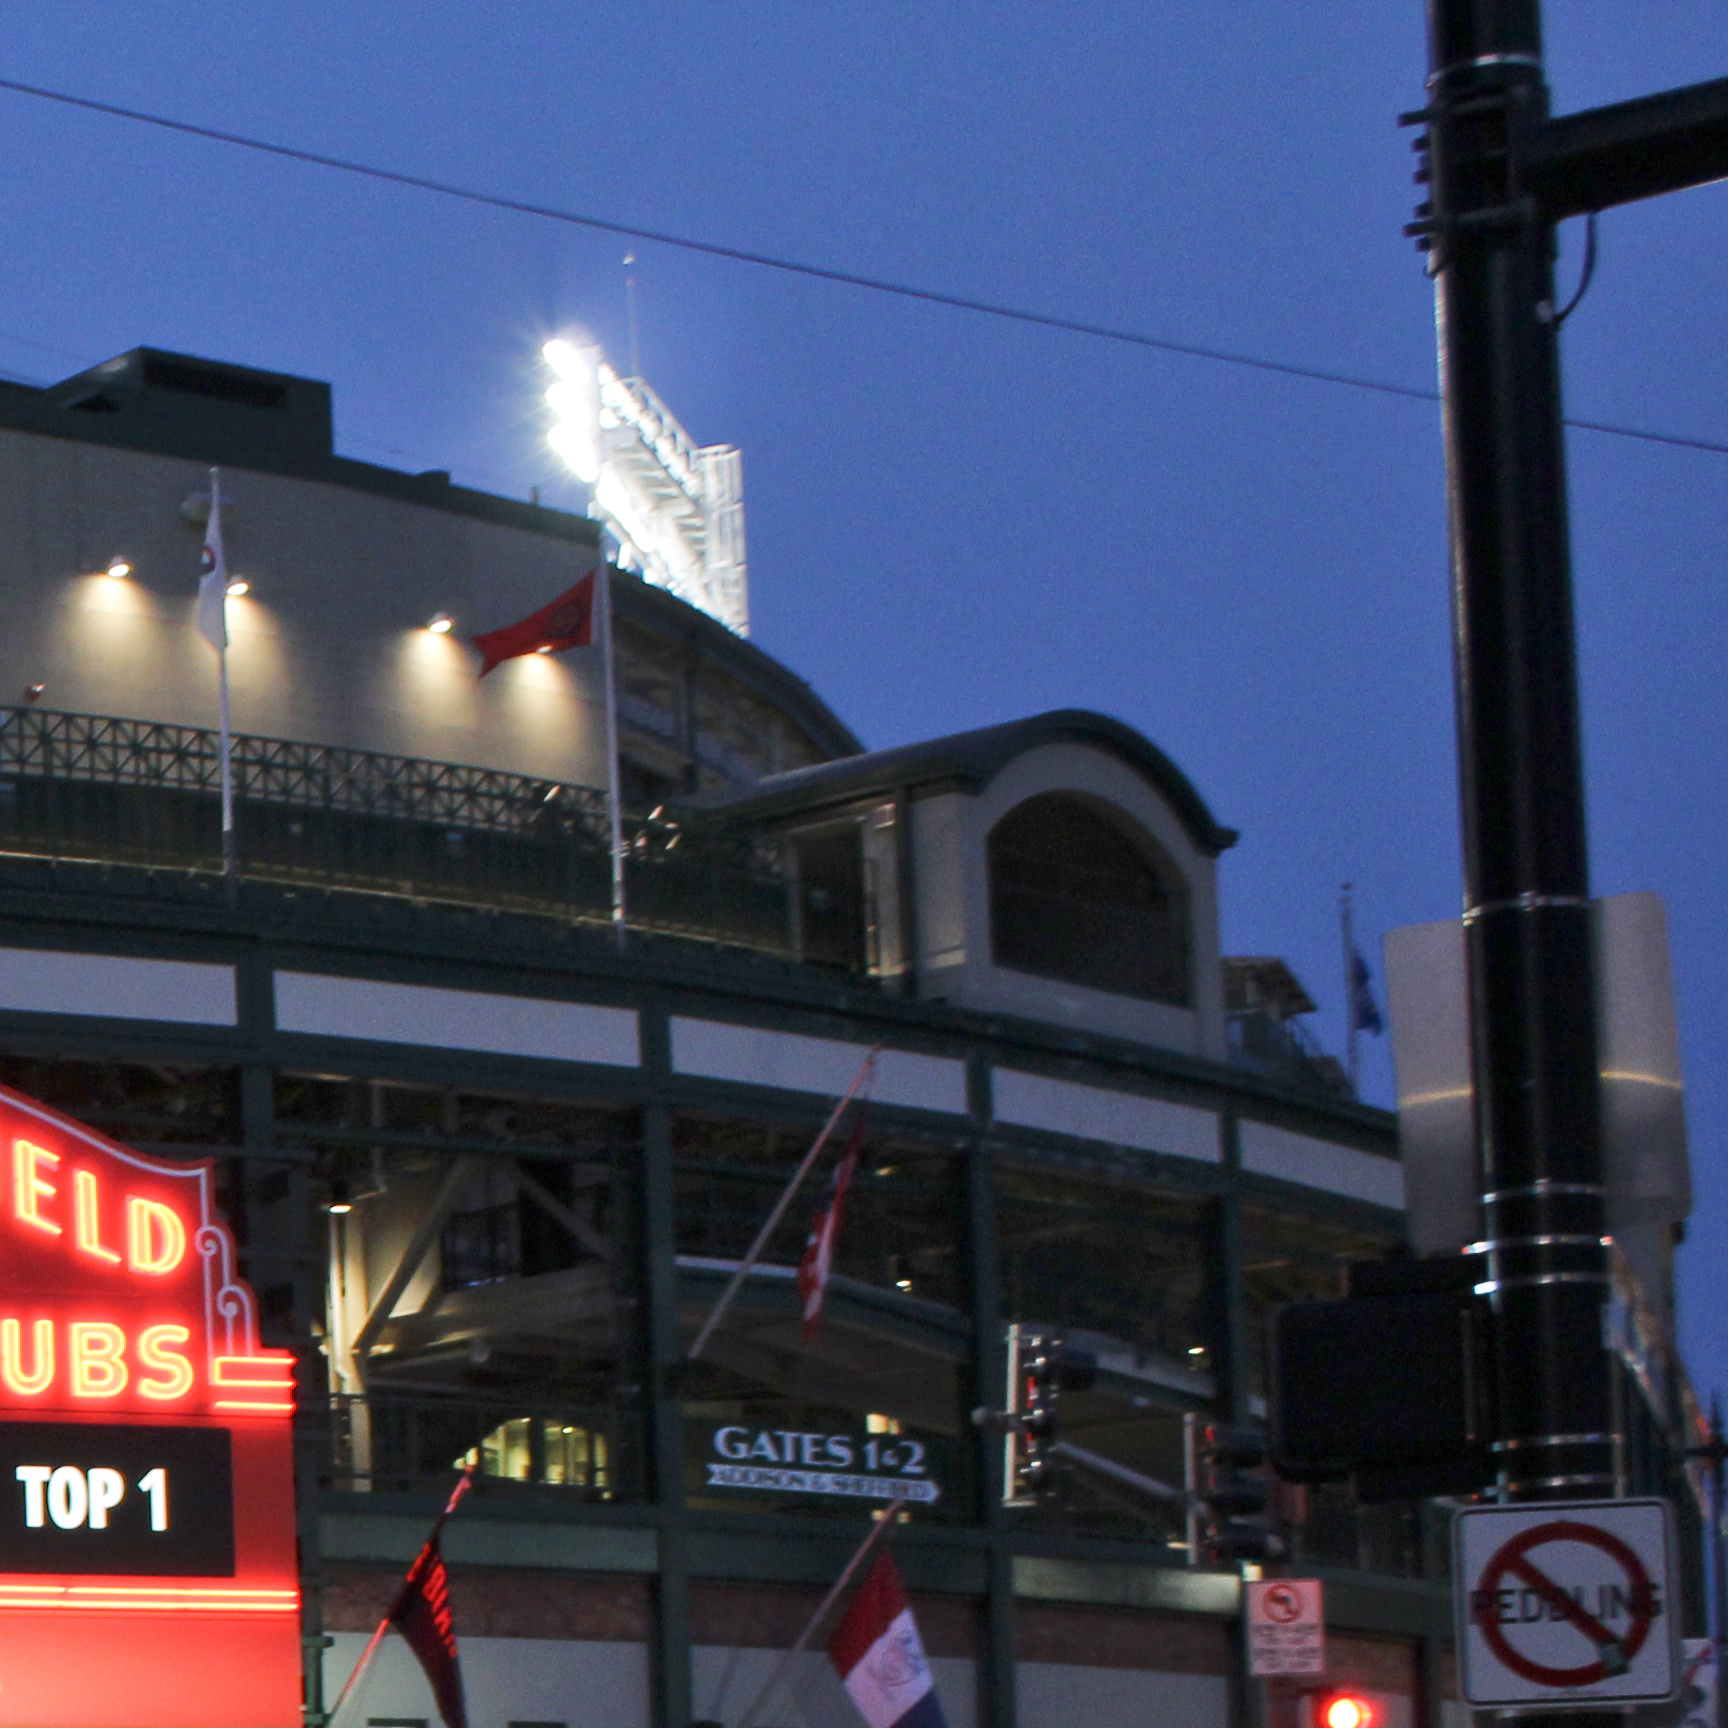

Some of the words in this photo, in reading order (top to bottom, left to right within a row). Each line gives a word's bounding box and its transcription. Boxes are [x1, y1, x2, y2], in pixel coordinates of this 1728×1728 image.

[713, 1426, 855, 1468] GATES
[14, 1465, 126, 1530] TOP
[135, 1467, 168, 1532] 1
